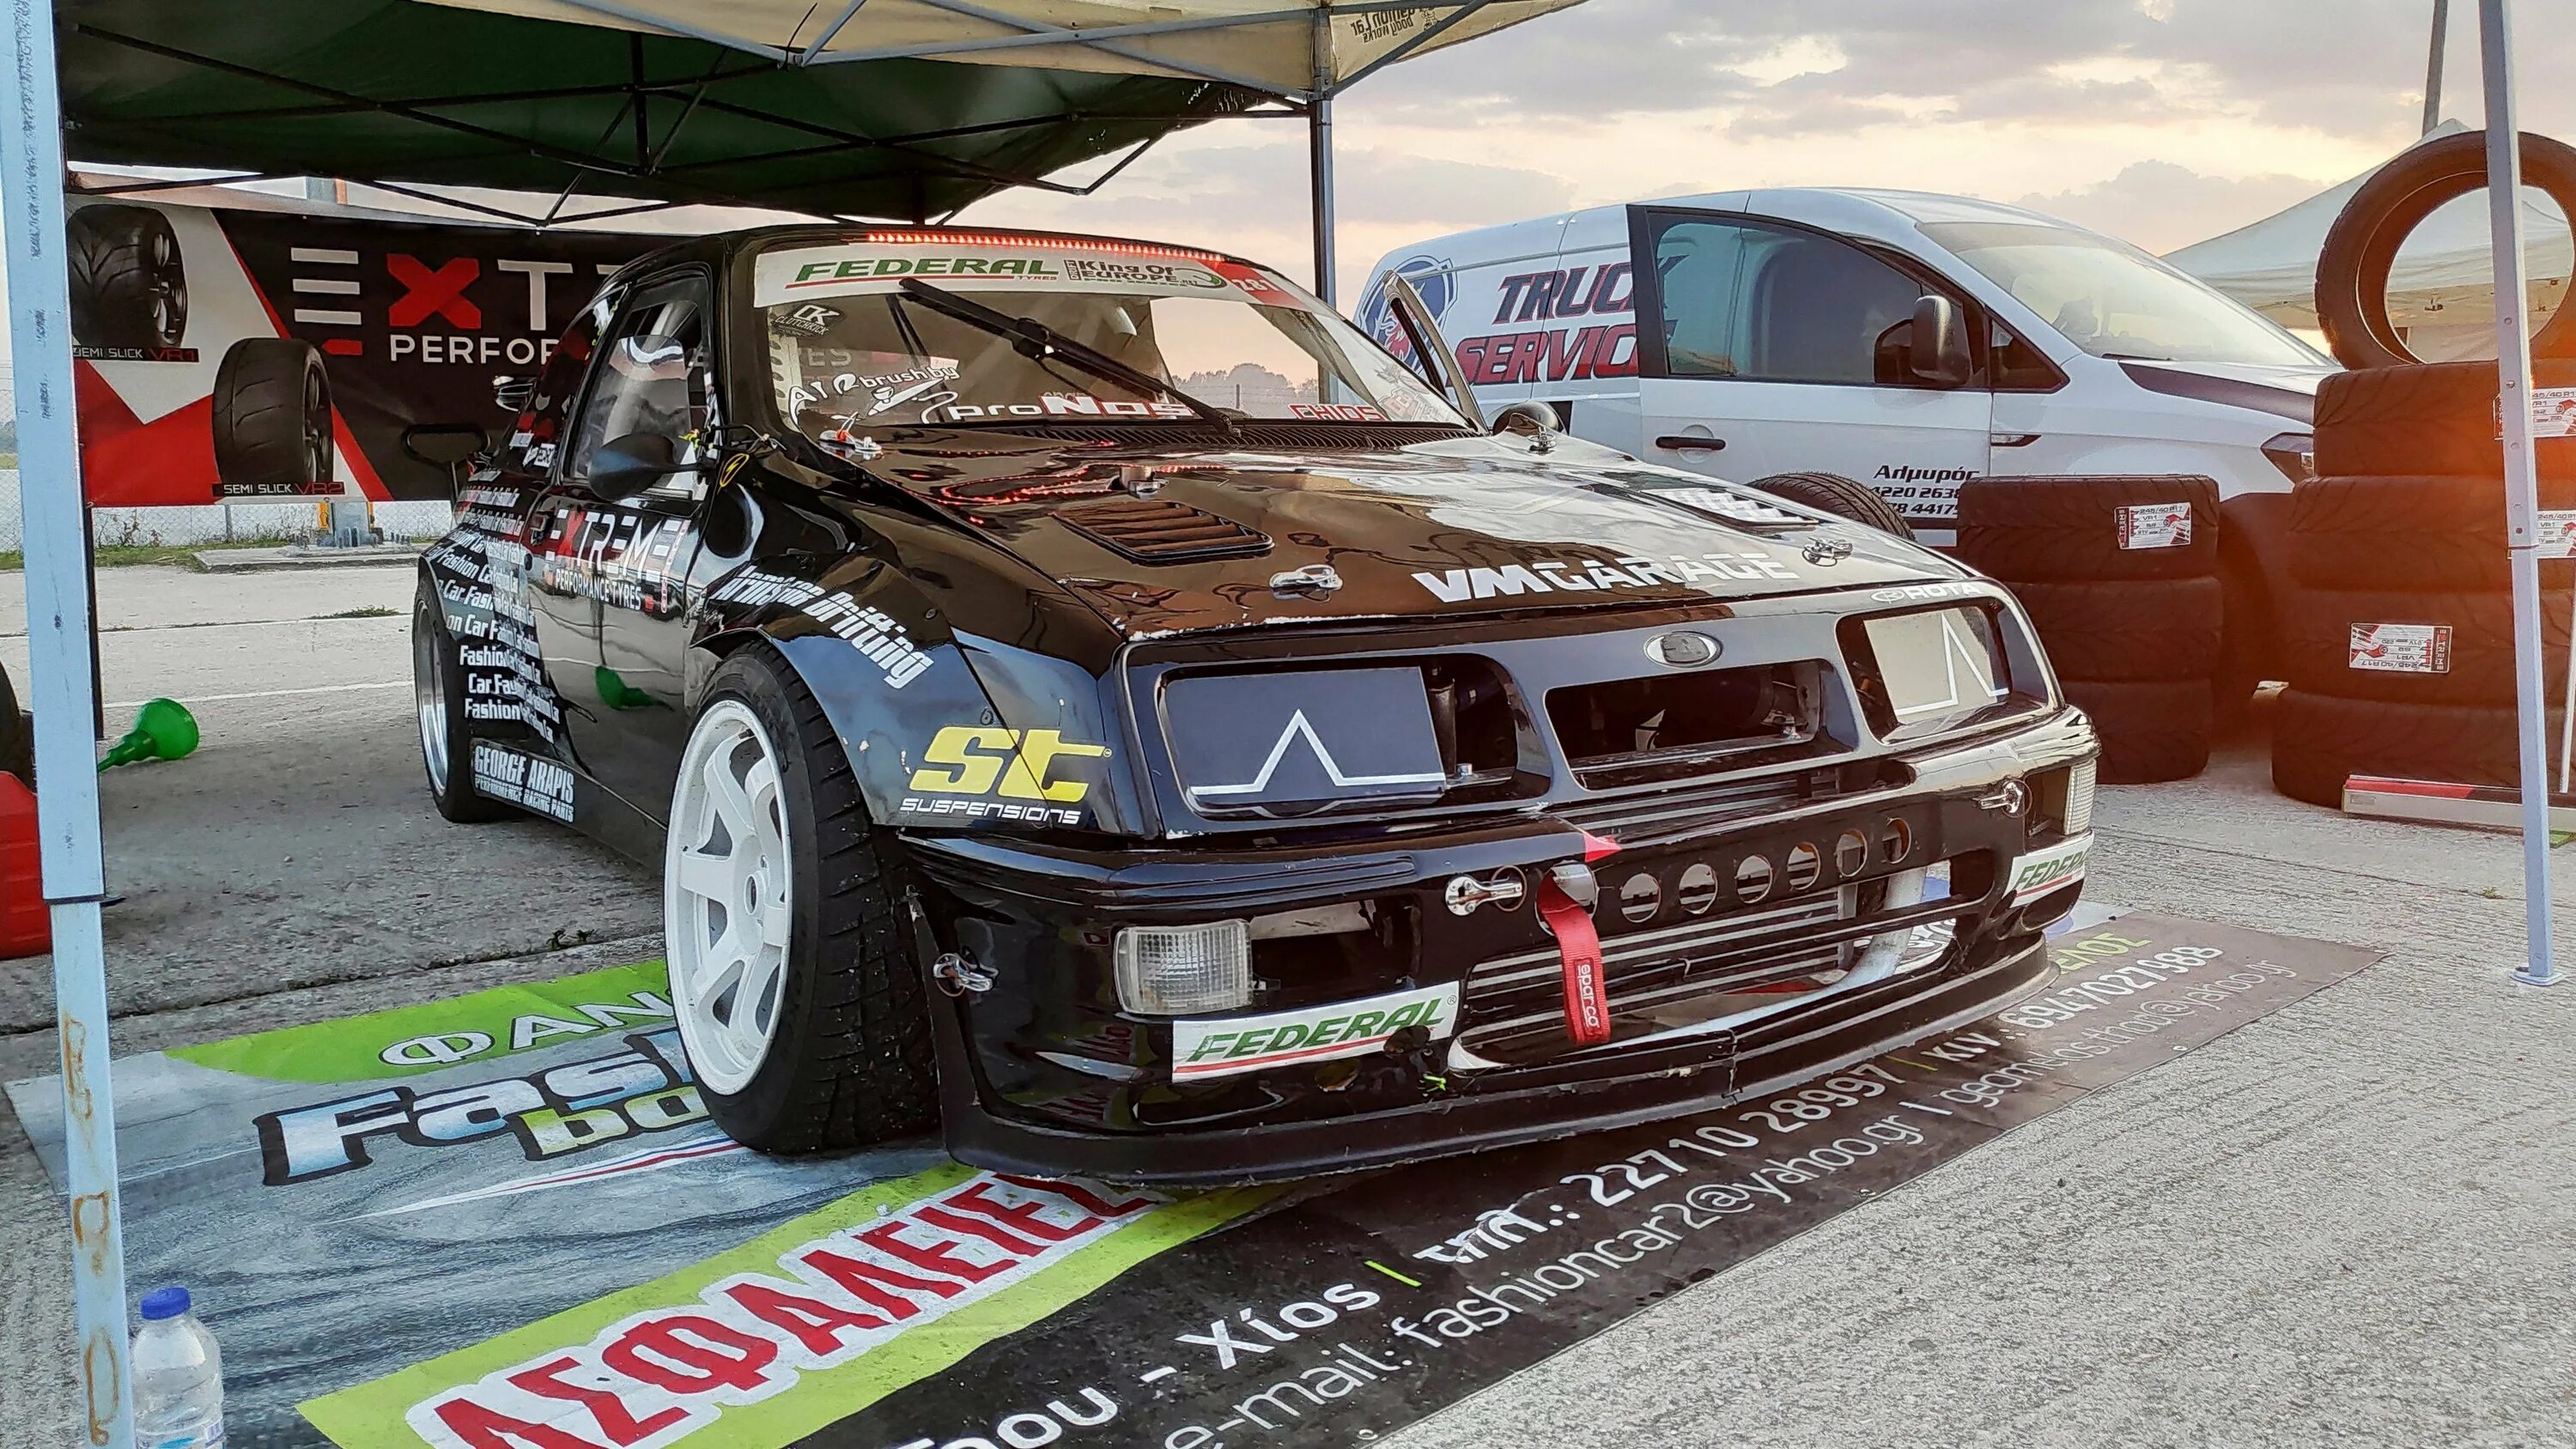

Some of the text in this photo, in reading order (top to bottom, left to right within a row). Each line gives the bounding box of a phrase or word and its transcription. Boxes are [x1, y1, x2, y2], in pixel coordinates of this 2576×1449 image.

[290, 247, 627, 330] EXT
[794, 258, 1060, 282] FEDERAL
[1080, 260, 1140, 274] King
[1492, 255, 1690, 324] TRUC
[108, 347, 143, 359] SLICK
[1455, 320, 1679, 385] SERVIC
[1289, 403, 1386, 421] CHIOS
[224, 482, 345, 495] SEMI SLICK VR2
[612, 581, 642, 611] TYRES
[801, 592, 935, 689] Drifting
[465, 698, 521, 720] Fashion
[474, 745, 574, 804] GEORGE ARAPIS
[899, 797, 1083, 825] SUSPENSIONS
[380, 989, 675, 1066] ΦΑΝ
[1186, 997, 1447, 1063] FEDERAL
[1739, 1063, 1907, 1133] 28997
[1997, 946, 2227, 1029] 6947027988
